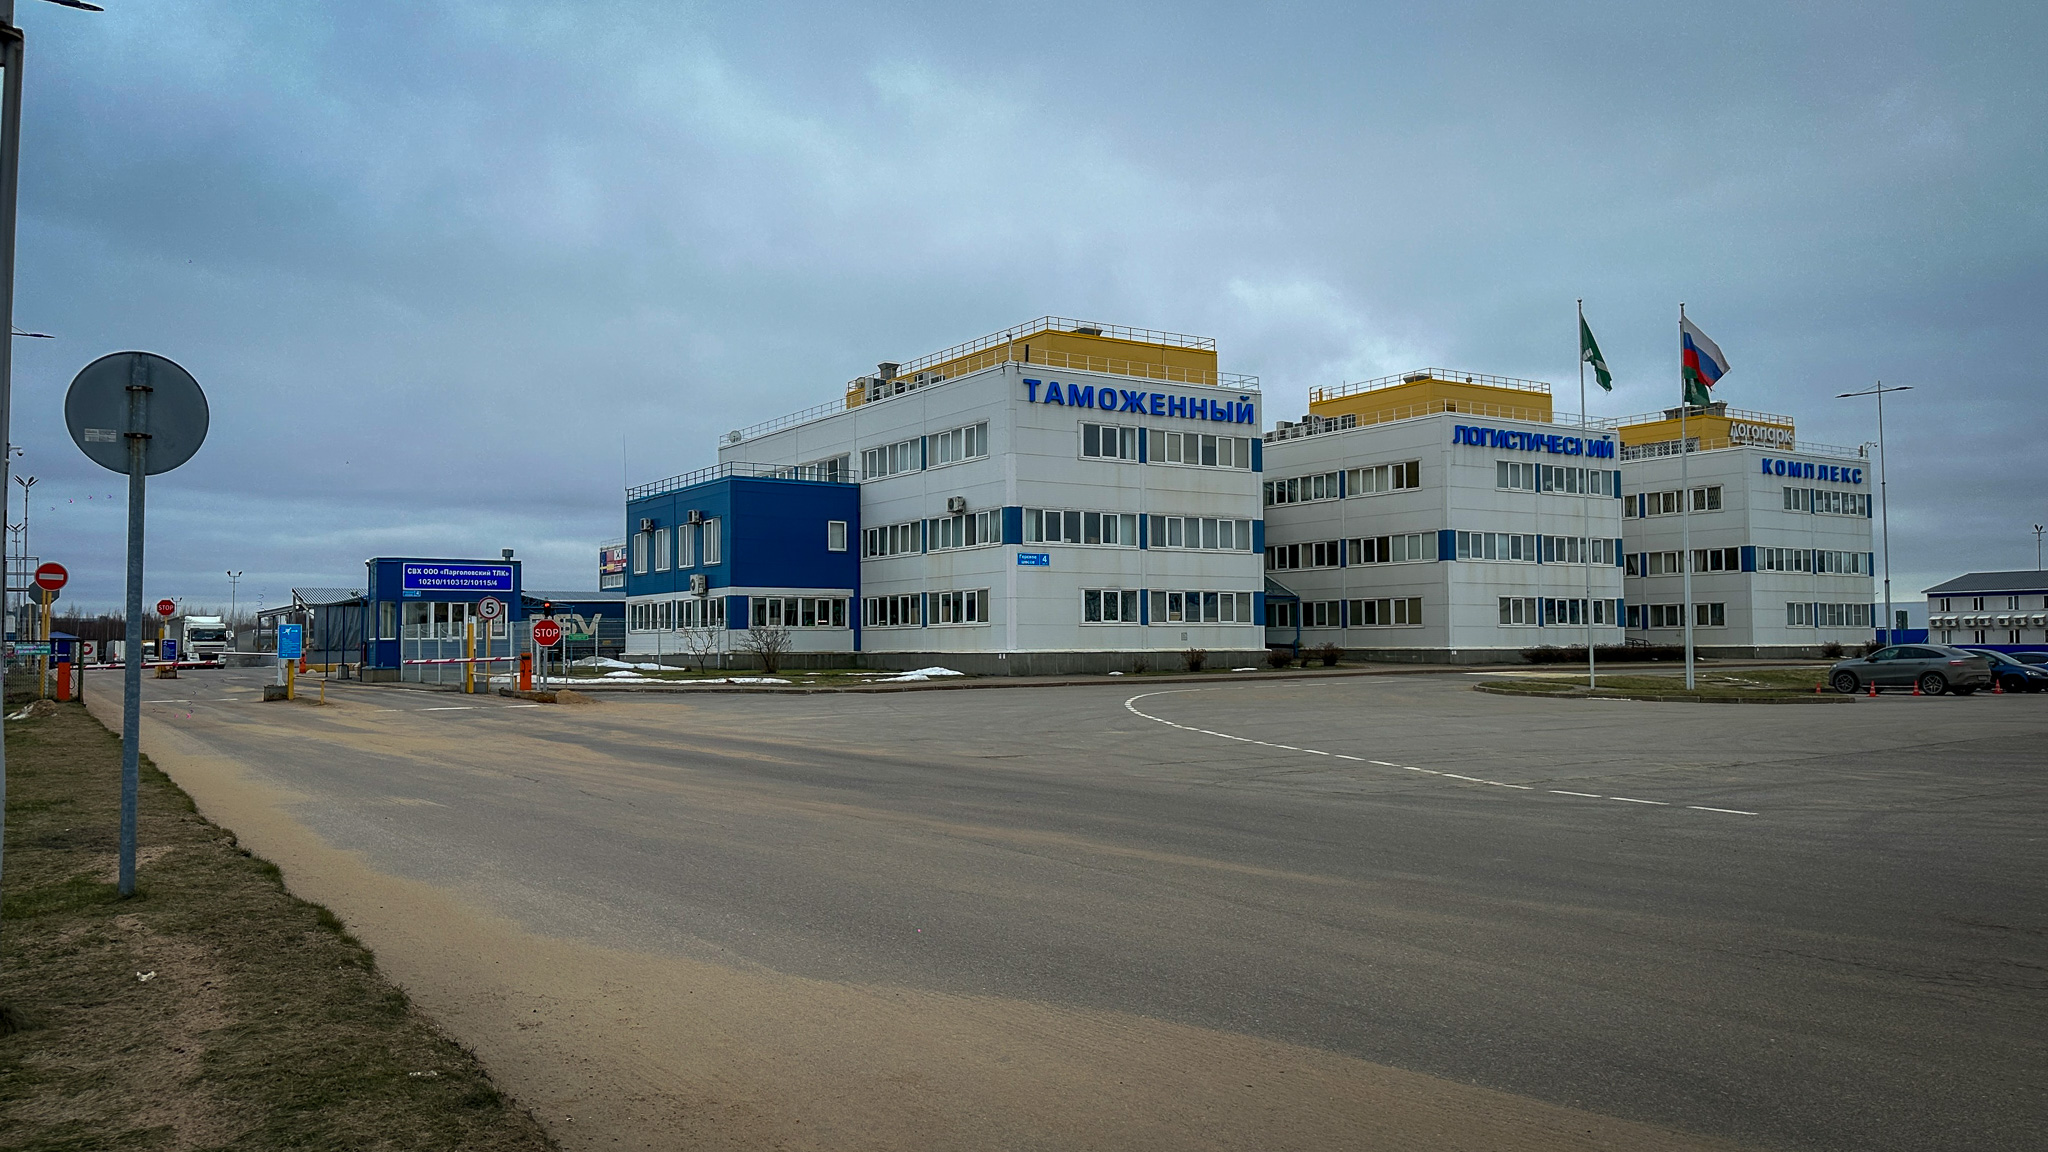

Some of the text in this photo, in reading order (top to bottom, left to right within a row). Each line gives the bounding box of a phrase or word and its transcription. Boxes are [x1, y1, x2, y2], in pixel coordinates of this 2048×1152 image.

[1023, 378, 1254, 425] ТАМОЖЕННЫЙ
[1453, 424, 1614, 459] ЛОГИСТИЧЕСКИЙ
[1762, 457, 1862, 484] КОМПЛЕКС
[407, 567, 422, 575] СВХ
[440, 568, 491, 577] «Парголовский
[492, 569, 509, 577] ТЛК»
[485, 602, 495, 615] 5
[534, 628, 559, 638] STOP
